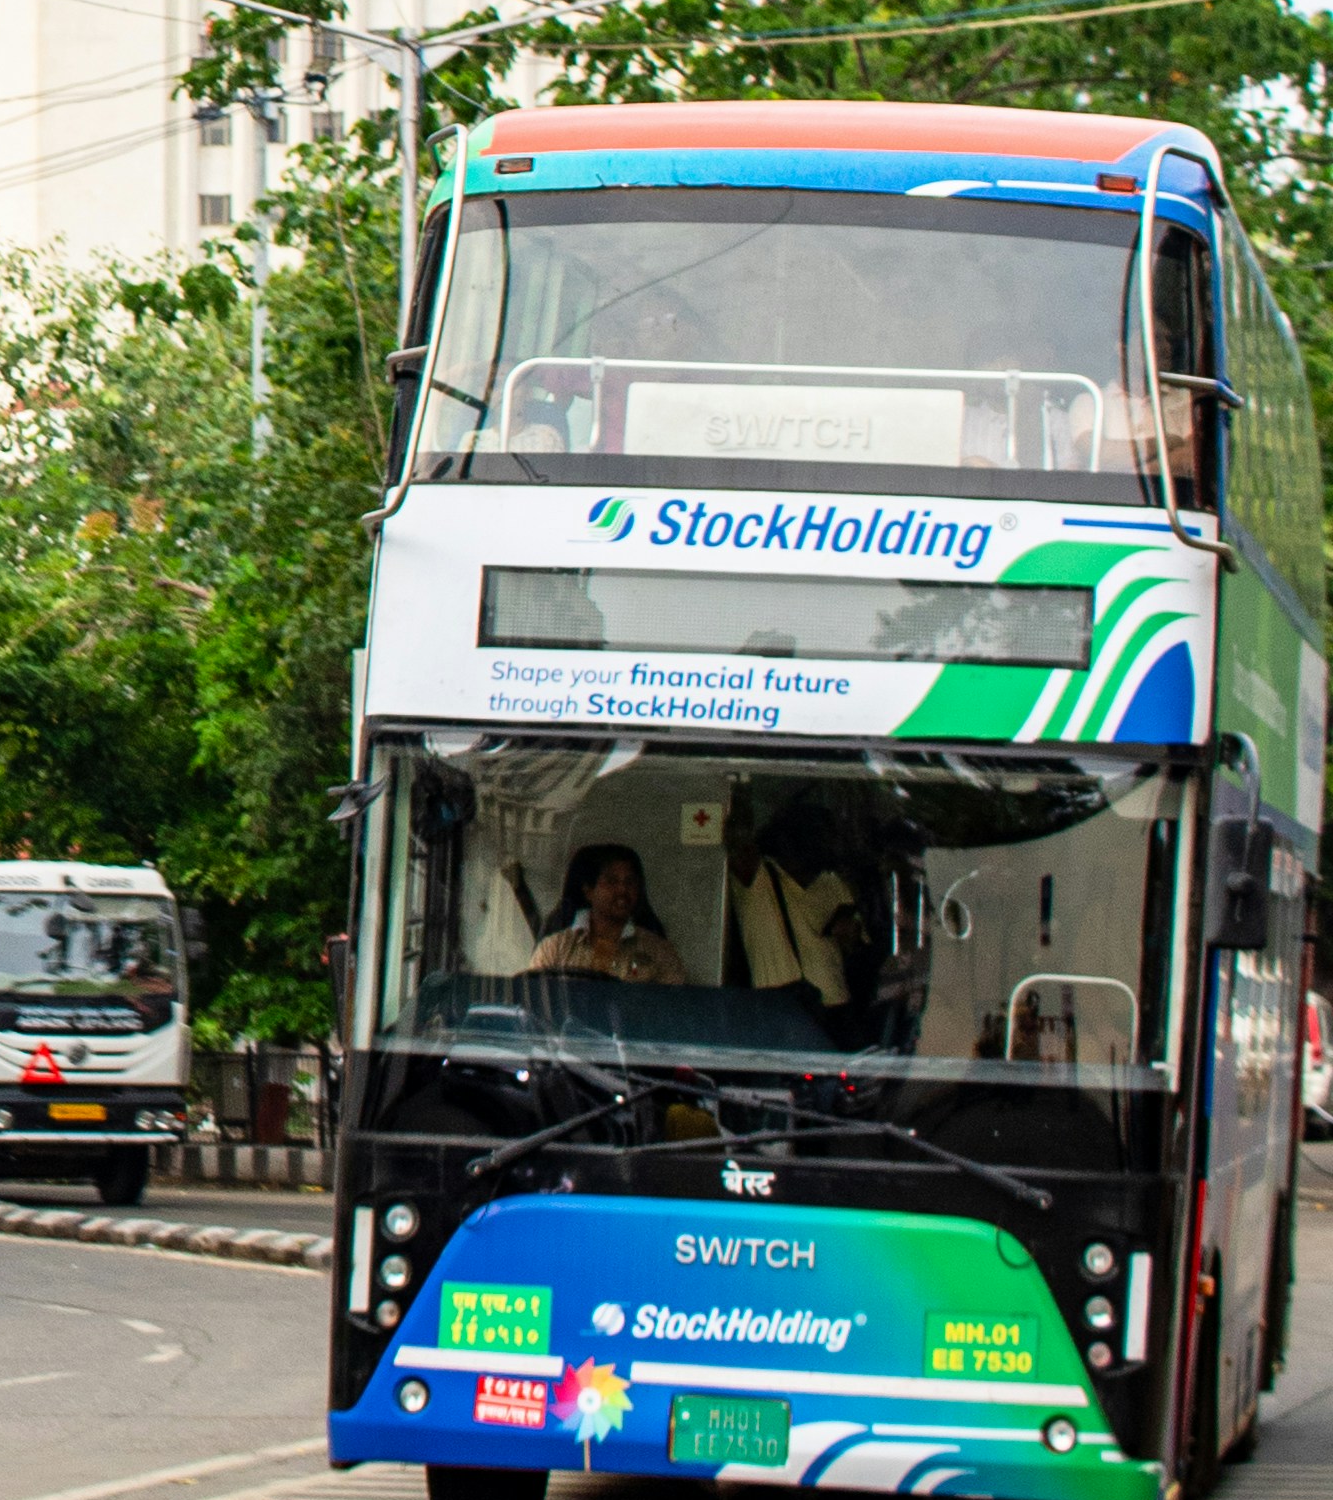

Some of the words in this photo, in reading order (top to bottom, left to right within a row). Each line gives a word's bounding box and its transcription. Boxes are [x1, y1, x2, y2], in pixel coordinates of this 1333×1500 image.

[649, 498, 993, 570] StockHolding
[490, 660, 564, 687] Shape
[571, 667, 622, 687] your
[629, 662, 754, 690] financial
[763, 668, 851, 695] future
[488, 692, 578, 719] through
[586, 693, 781, 728] StockHolding
[721, 1159, 778, 1196] बेस्ट
[675, 1234, 816, 1269] SWITCH
[632, 1303, 852, 1353] StockHolding
[944, 1321, 1020, 1346] MH.01
[932, 1347, 964, 1372] EE
[973, 1349, 1033, 1374] 7530
[708, 1408, 762, 1431] MH01
[693, 1433, 779, 1459] EE7530
